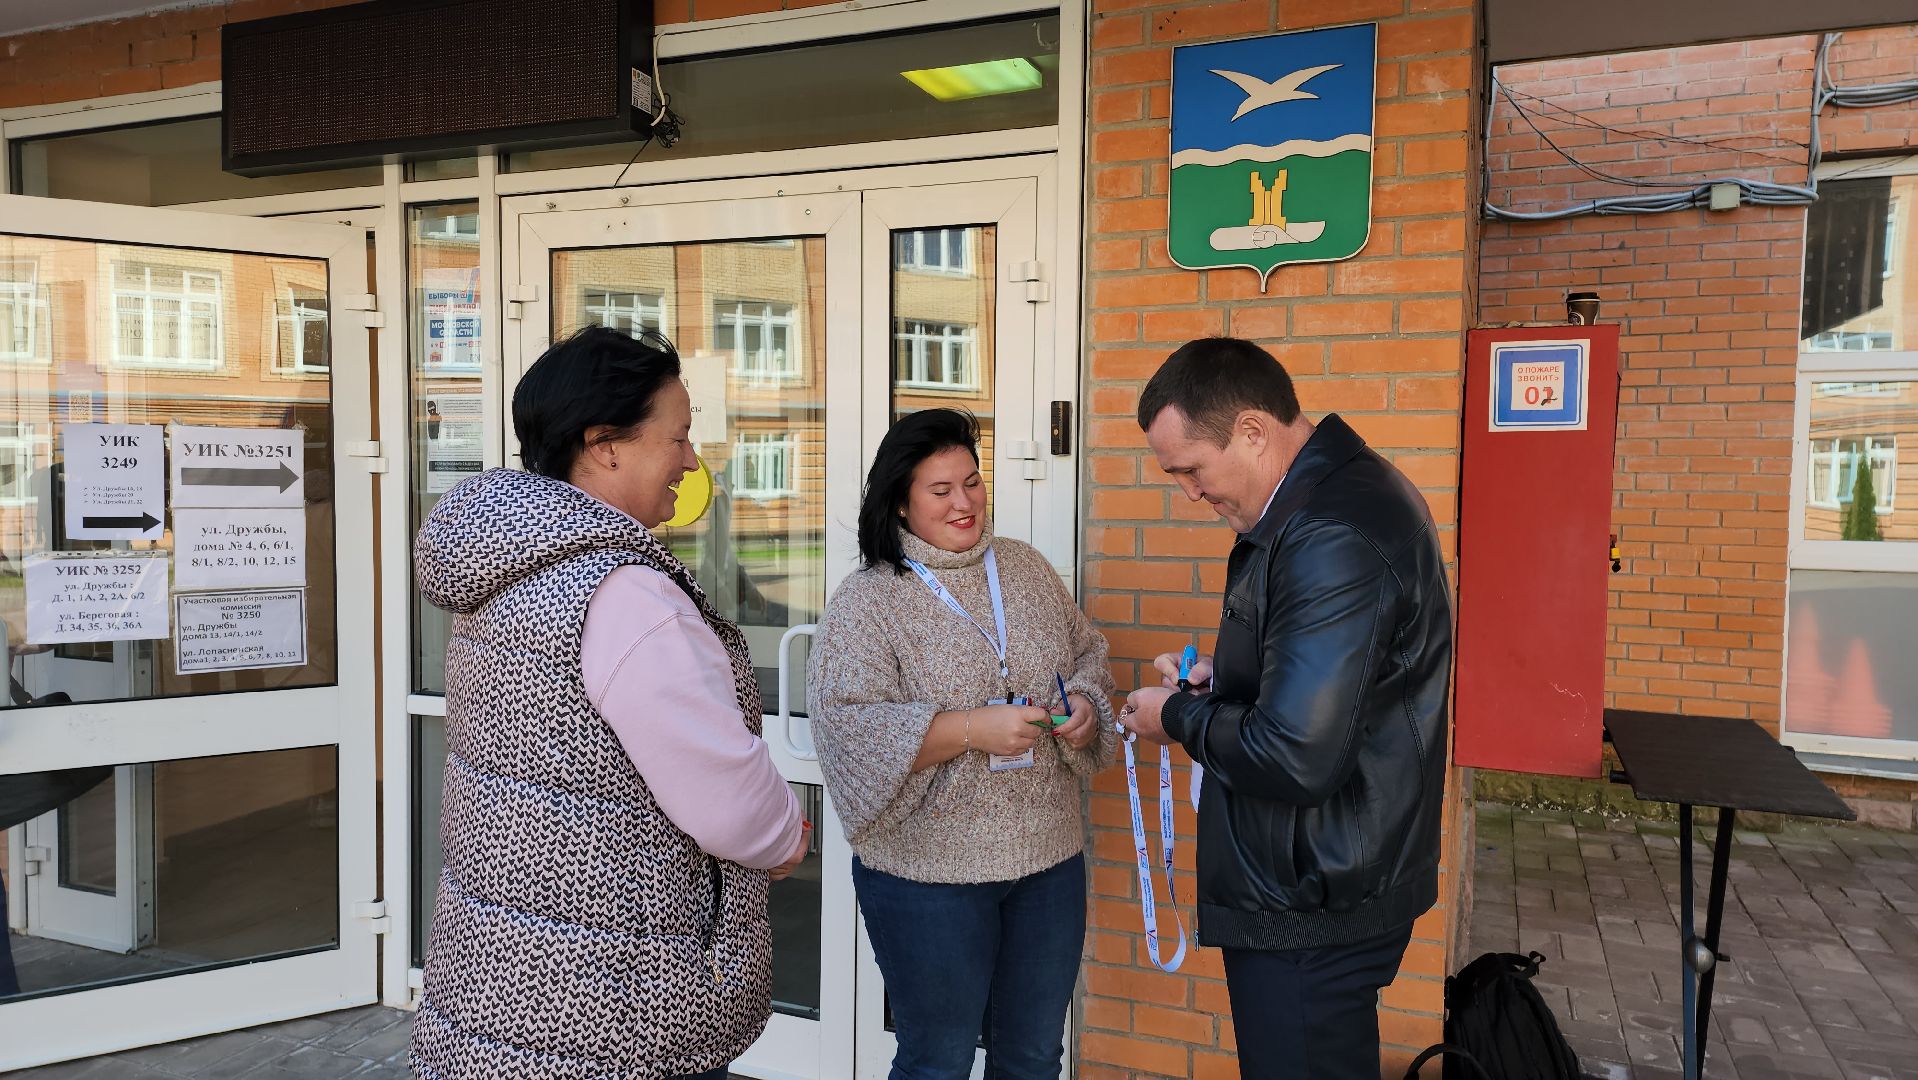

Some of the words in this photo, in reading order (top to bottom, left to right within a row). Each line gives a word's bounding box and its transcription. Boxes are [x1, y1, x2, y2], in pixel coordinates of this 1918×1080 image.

[100, 435, 140, 447] УИК
[183, 443, 228, 457] УИК
[101, 457, 138, 469] 3249
[201, 527, 222, 538] ул.
[225, 524, 287, 536] Дружбы,
[193, 543, 224, 552] дома
[228, 541, 243, 551] №
[246, 541, 257, 551] 4,
[259, 541, 270, 551] 6,
[191, 557, 213, 568] 8/1,
[217, 557, 239, 567] 8/2,
[243, 557, 259, 567] 10,
[264, 556, 280, 566] 12,
[284, 556, 296, 565] 15
[55, 566, 90, 576] УИК
[93, 565, 109, 576] №
[112, 564, 142, 576] 3252
[64, 584, 80, 592] ул.
[82, 582, 127, 592] Дружбы
[99, 593, 108, 601] 2,
[183, 597, 232, 605] Участковая
[234, 594, 297, 602] избирательная
[59, 613, 75, 622] ул.
[78, 611, 132, 621] Береговая
[221, 612, 234, 620] №
[237, 611, 261, 620] 3250
[69, 623, 85, 632] 34,
[88, 623, 103, 632] 35,
[197, 622, 238, 632] Дружбы
[182, 634, 208, 642] дома
[182, 650, 196, 658] ул.
